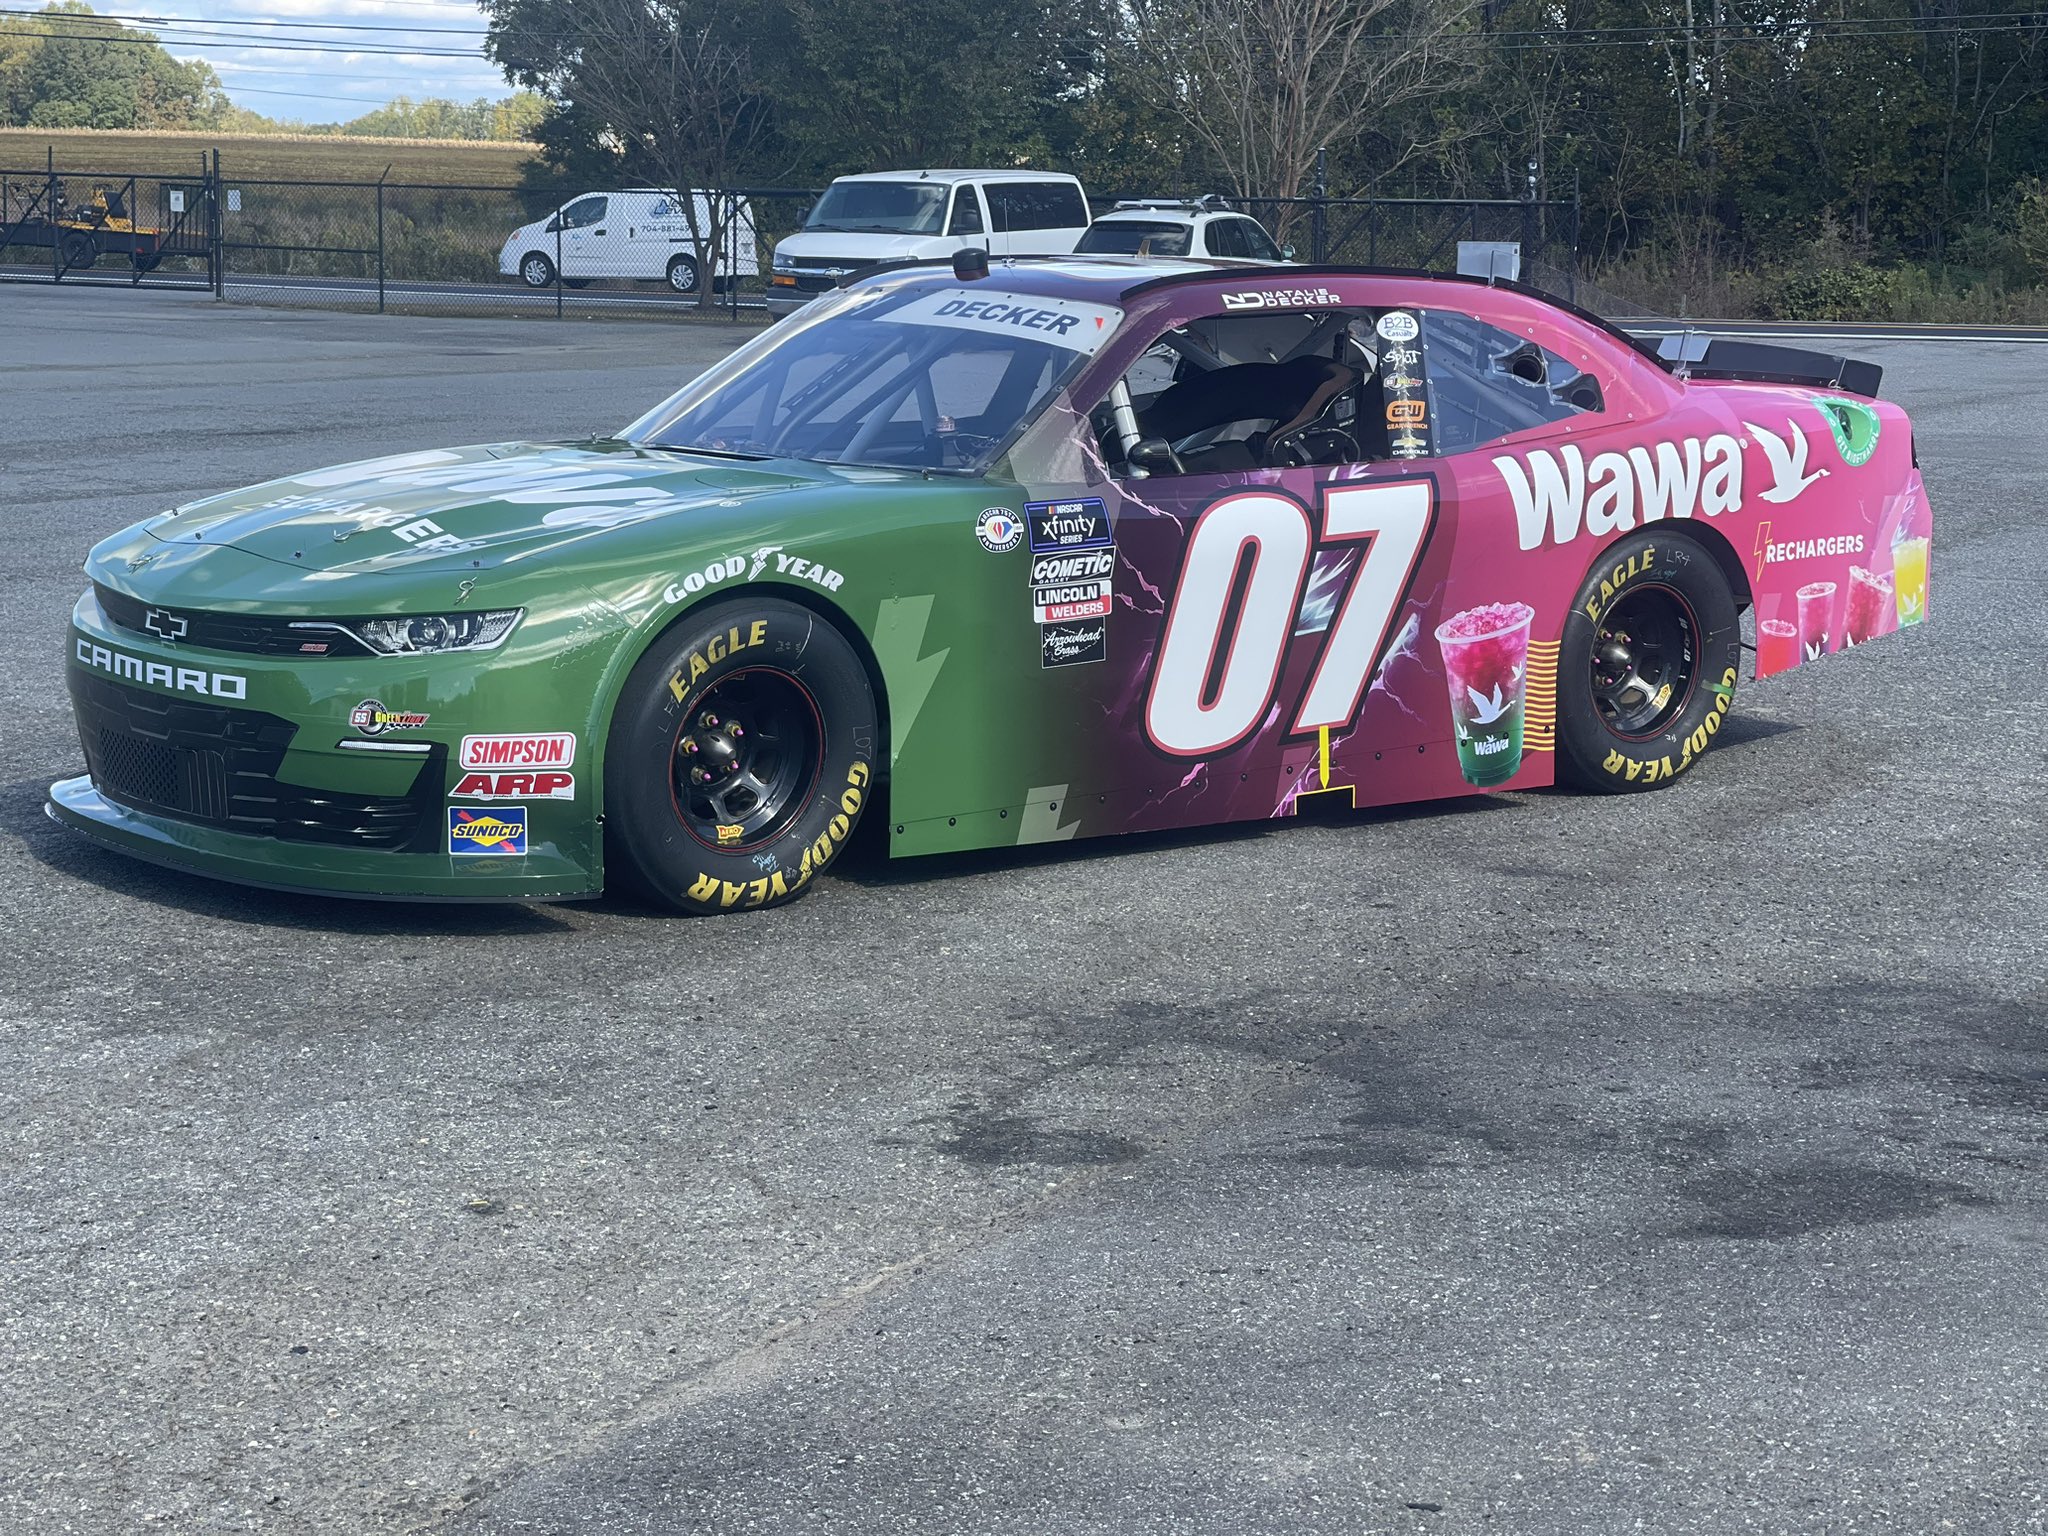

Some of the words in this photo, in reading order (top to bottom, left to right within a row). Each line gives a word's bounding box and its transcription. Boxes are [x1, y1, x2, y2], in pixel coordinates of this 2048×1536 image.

[641, 224, 701, 232] 704-881-49
[1261, 288, 1329, 299] NATALIE
[1265, 294, 1341, 307] DECKER
[933, 300, 1080, 335] DECKER
[1383, 316, 1413, 329] B2B
[1492, 433, 1744, 551] Wawa
[981, 509, 999, 523] NASCAR
[1056, 504, 1083, 514] NASCAR
[1041, 514, 1096, 541] xfinity
[981, 533, 1020, 551] ANNIVERSARY
[1060, 534, 1083, 544] SERIES
[1766, 534, 1865, 563] RECHARGERS
[1034, 554, 1113, 580] COMETIC
[663, 556, 746, 604] GOOD
[776, 553, 844, 592] YEAR
[1585, 547, 1656, 622] EAGLE
[1038, 585, 1098, 605] LINCOLN
[1051, 602, 1104, 618] WELDERS
[1143, 477, 1435, 757] 07
[1043, 627, 1102, 647] Arrowhead
[1054, 643, 1080, 655] Brass
[76, 638, 246, 700] CAMARO
[668, 619, 768, 703] EAGLE
[469, 739, 566, 764] SIMPSON
[1474, 738, 1510, 756] Wawa
[1602, 748, 1674, 783] YEAR
[454, 773, 574, 795] ARP
[455, 824, 522, 838] SUNOCO
[687, 870, 788, 908] YEAR
